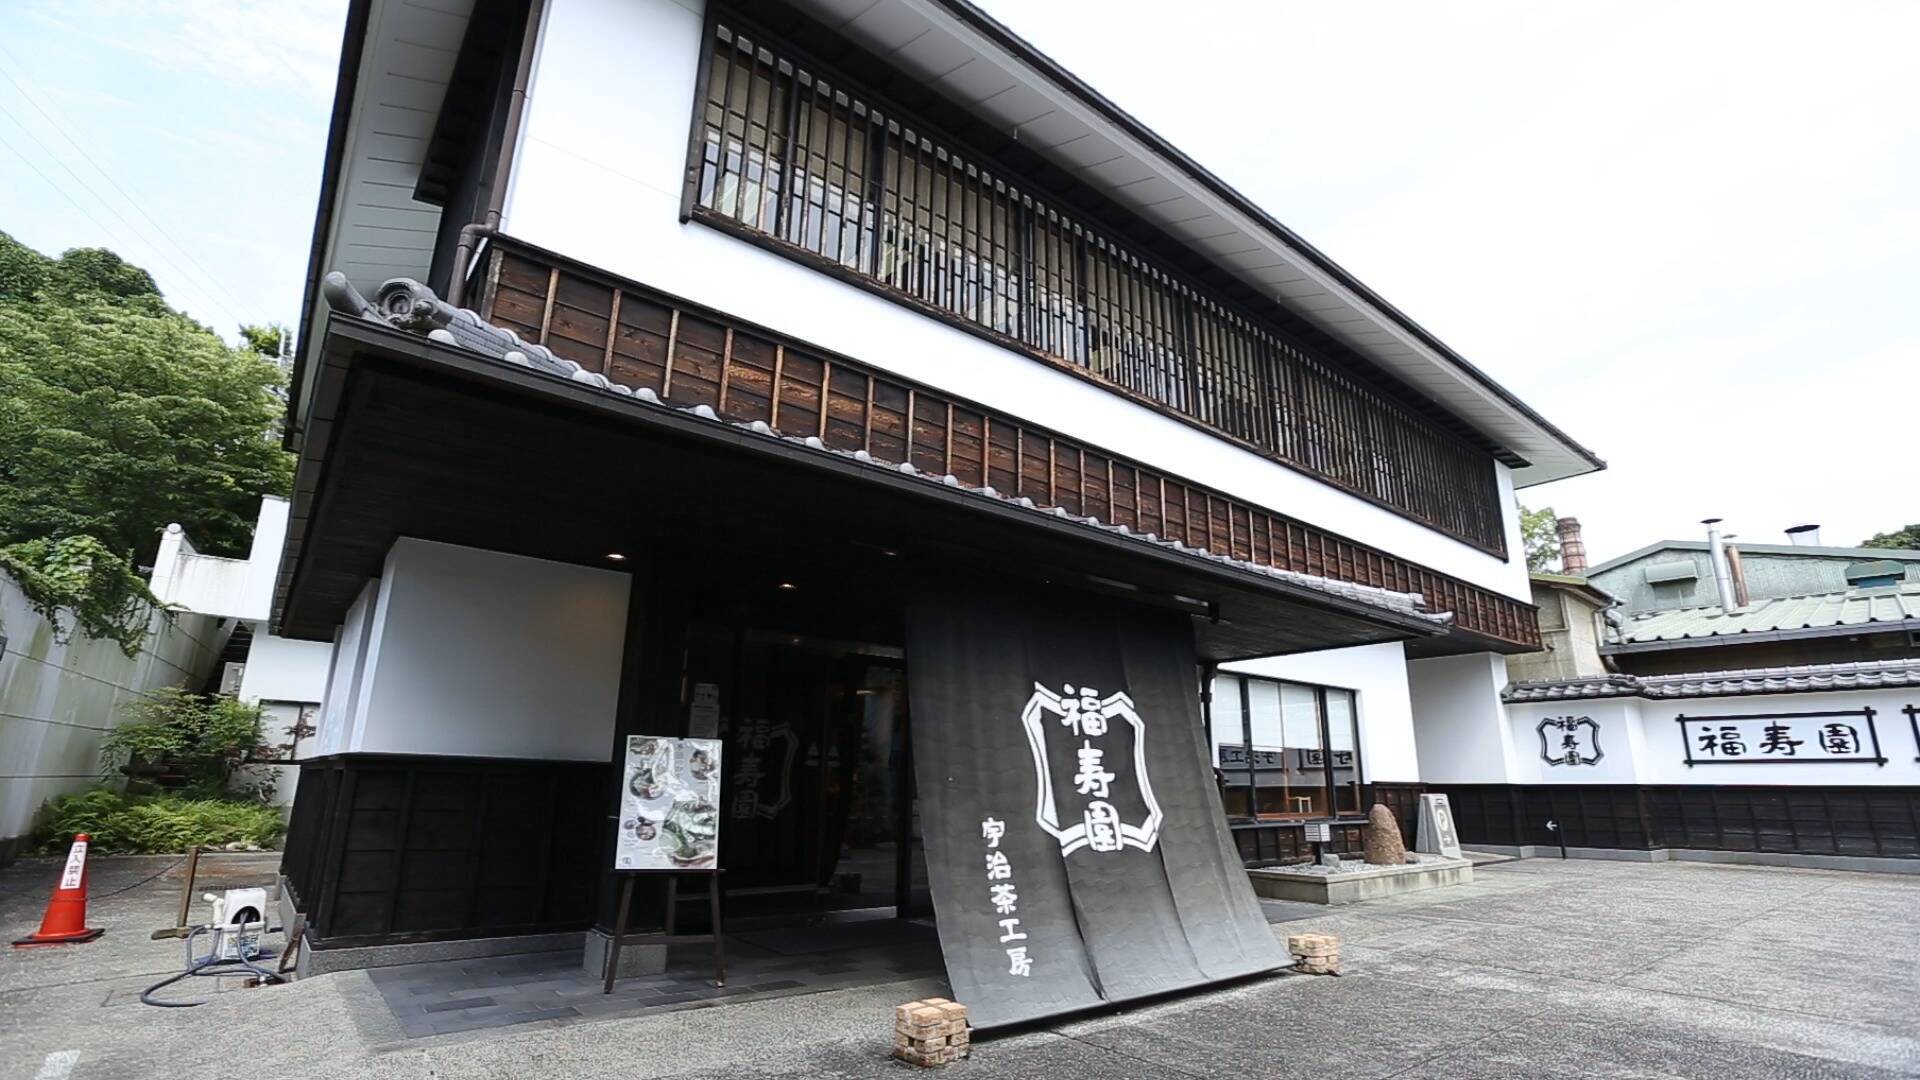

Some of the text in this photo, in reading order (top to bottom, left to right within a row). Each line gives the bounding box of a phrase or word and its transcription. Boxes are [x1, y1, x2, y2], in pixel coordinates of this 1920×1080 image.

[1556, 715, 1580, 766] 福寿園
[1699, 720, 1861, 756] 福寿園
[1060, 684, 1123, 851] 福寿園
[65, 844, 84, 887] 立入禁止
[982, 817, 1033, 977] 宇治茶工房
